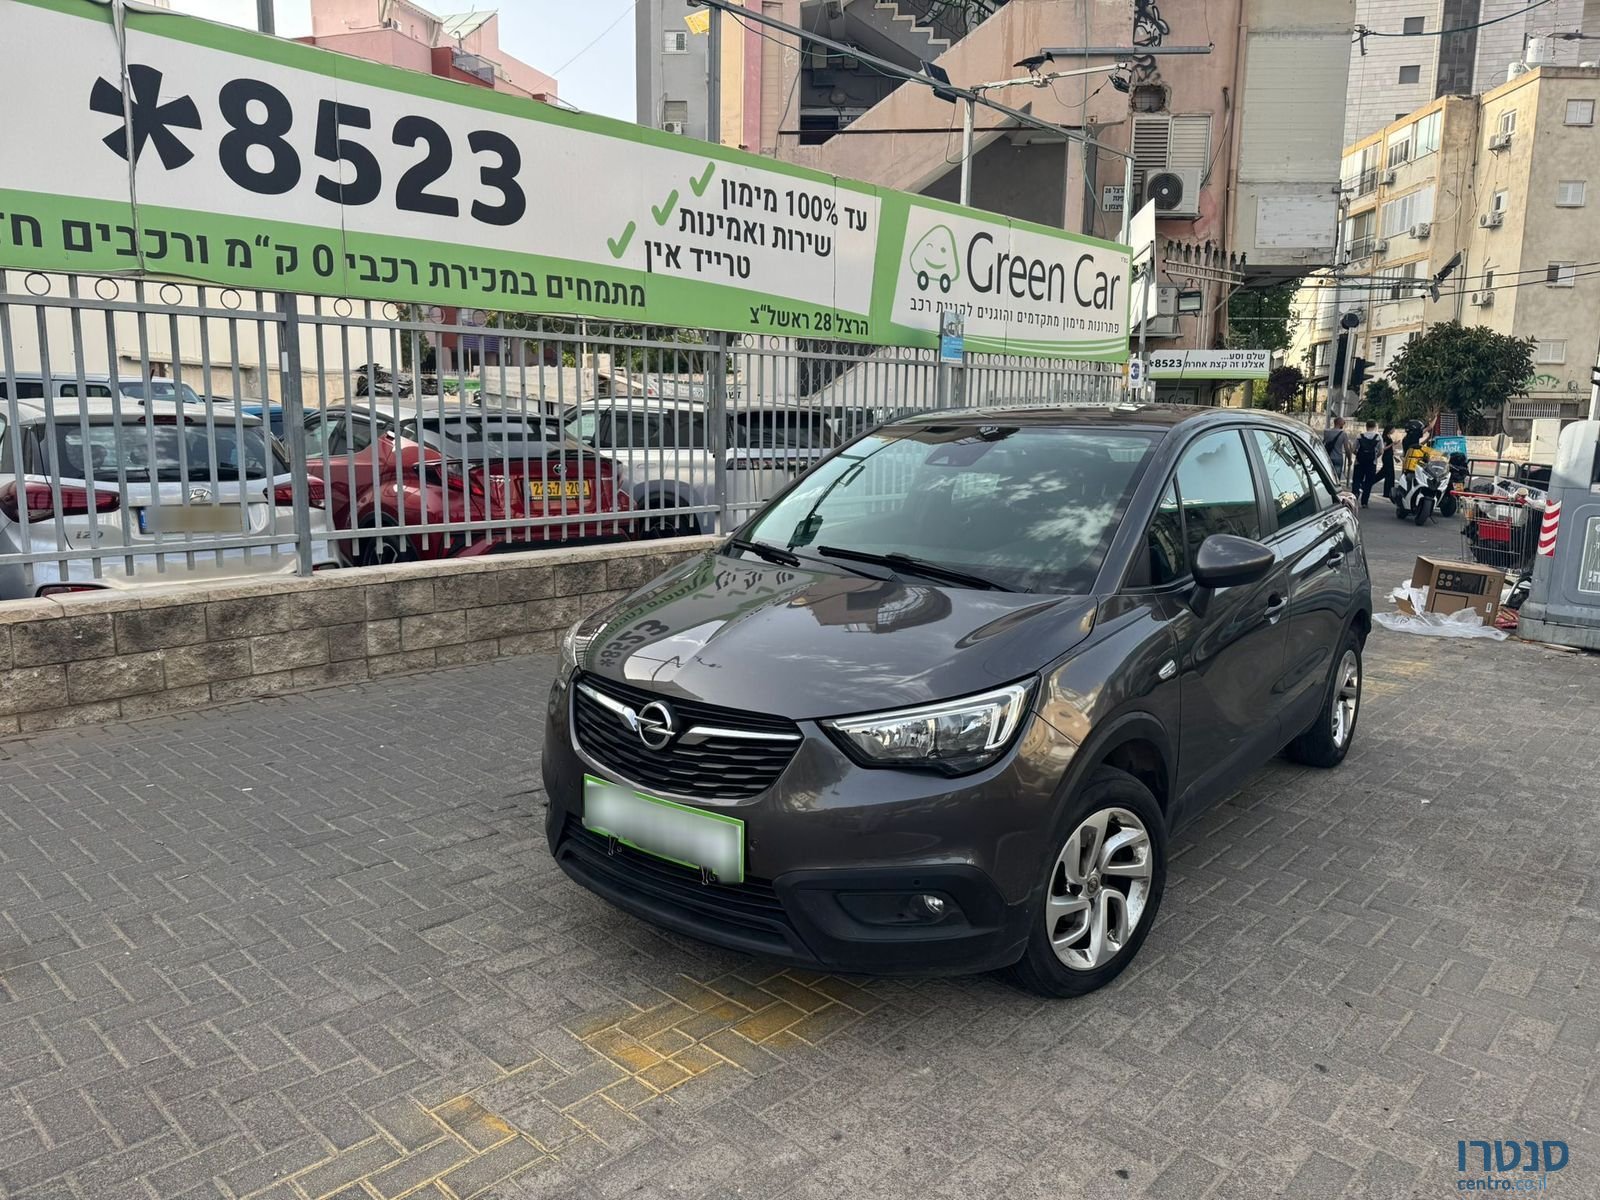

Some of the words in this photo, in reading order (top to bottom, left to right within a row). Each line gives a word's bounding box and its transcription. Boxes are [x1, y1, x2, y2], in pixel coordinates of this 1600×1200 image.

[721, 178, 778, 213] מימון
[785, 190, 839, 226] 100%
[679, 207, 766, 246] ואמינות
[844, 206, 868, 231] עד
[62, 219, 210, 264] ורכבים
[772, 226, 832, 257] שירות
[312, 244, 335, 277] 0
[345, 253, 418, 285] רכבי
[644, 240, 682, 273] אין
[689, 247, 751, 279] טרייד
[429, 262, 538, 297] במכירת
[966, 231, 1066, 304] Green
[1073, 253, 1121, 311] Car
[546, 274, 646, 308] מתמחים
[750, 303, 810, 330] ראשל"צ
[910, 297, 932, 313] רכב
[977, 305, 1013, 322] והוגנים
[814, 311, 832, 332] 28
[836, 313, 869, 336] הרצל
[1017, 310, 1060, 328] מתקדמים
[1062, 315, 1085, 331] מימון
[1087, 319, 1120, 334] פתרונות
[1184, 361, 1207, 369] אחרת
[1210, 361, 1228, 370] קצת
[1229, 361, 1239, 369] זה
[1241, 360, 1265, 369] אצלנו
[1246, 352, 1266, 360] שלם
